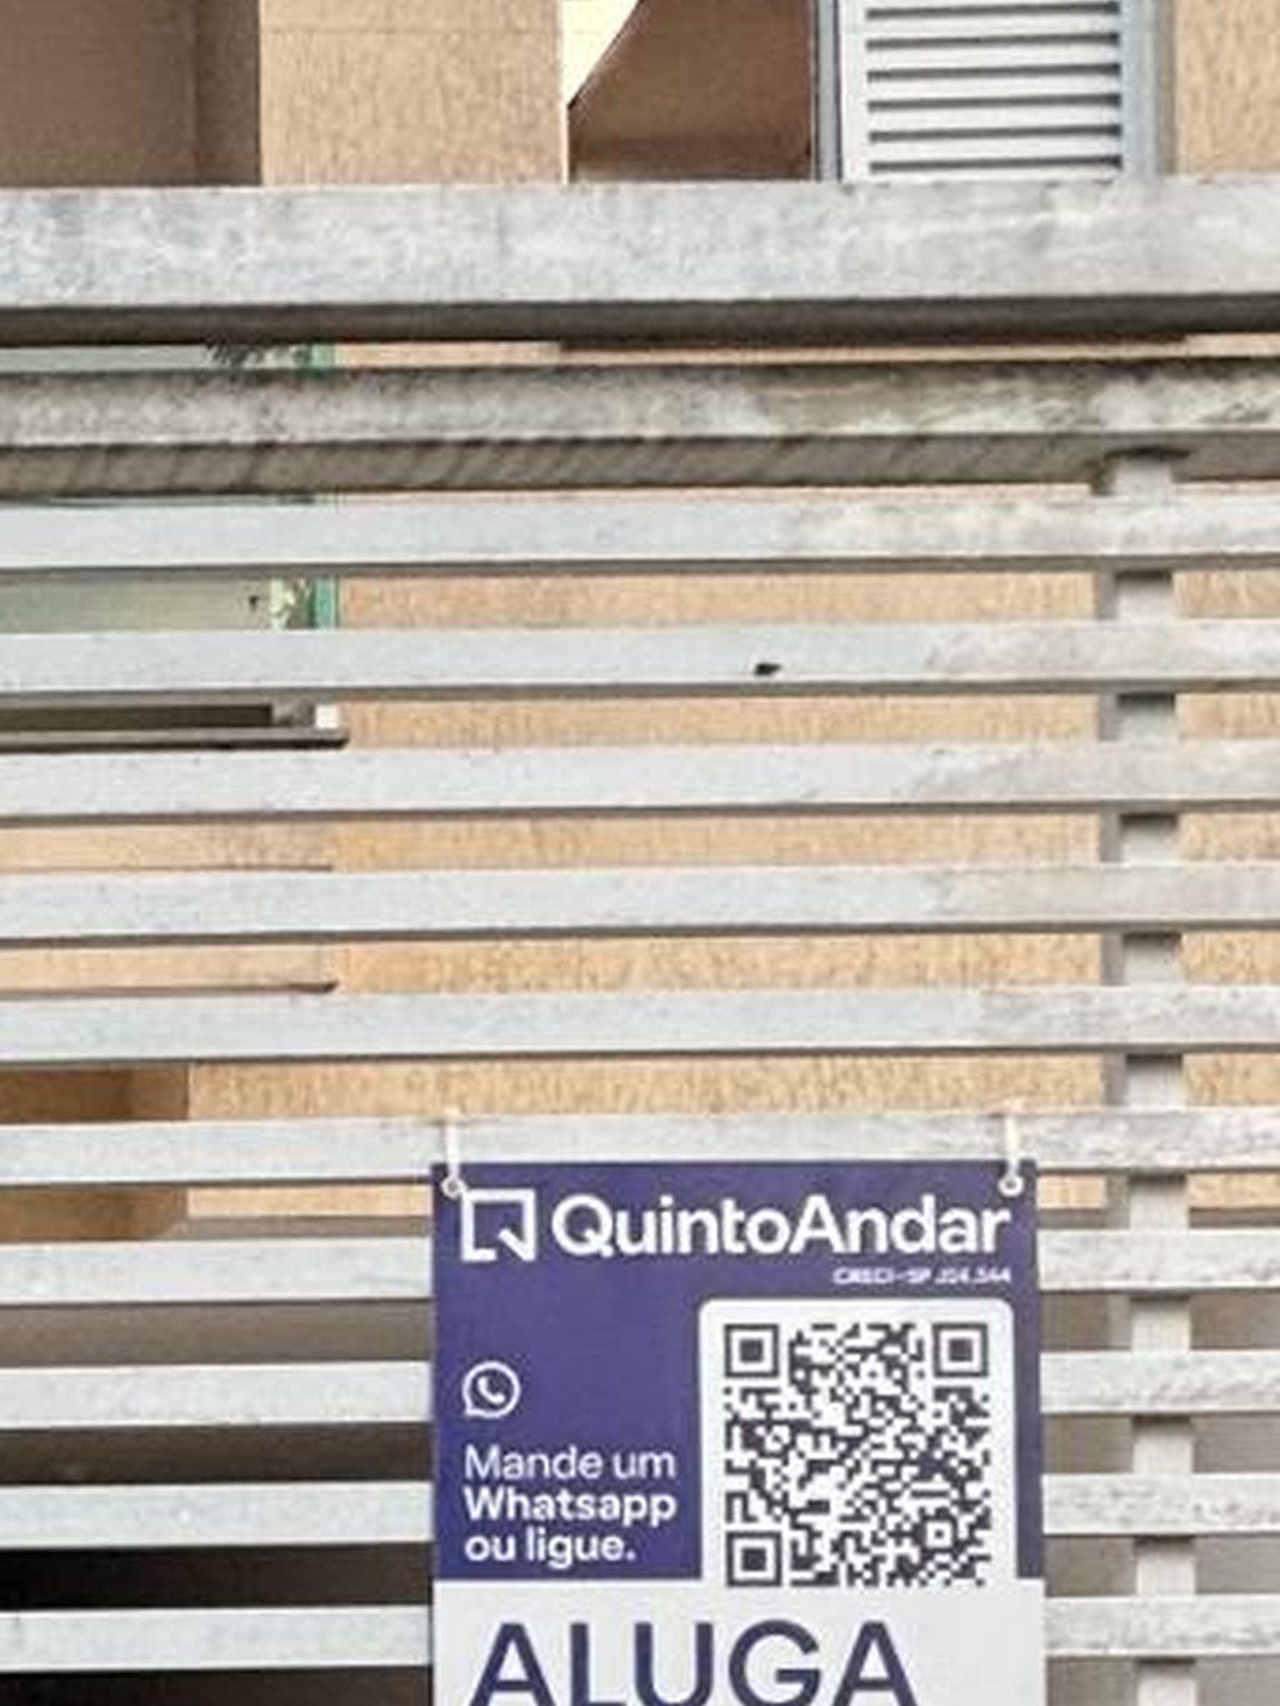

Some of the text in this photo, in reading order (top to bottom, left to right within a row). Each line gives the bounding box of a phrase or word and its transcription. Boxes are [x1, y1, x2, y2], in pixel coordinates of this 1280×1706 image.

[552, 1194, 1011, 1258] QuintoAndar
[465, 1444, 676, 1479] Mande um
[463, 1485, 677, 1527] Whatsapp
[465, 1526, 635, 1569] ou ligue.
